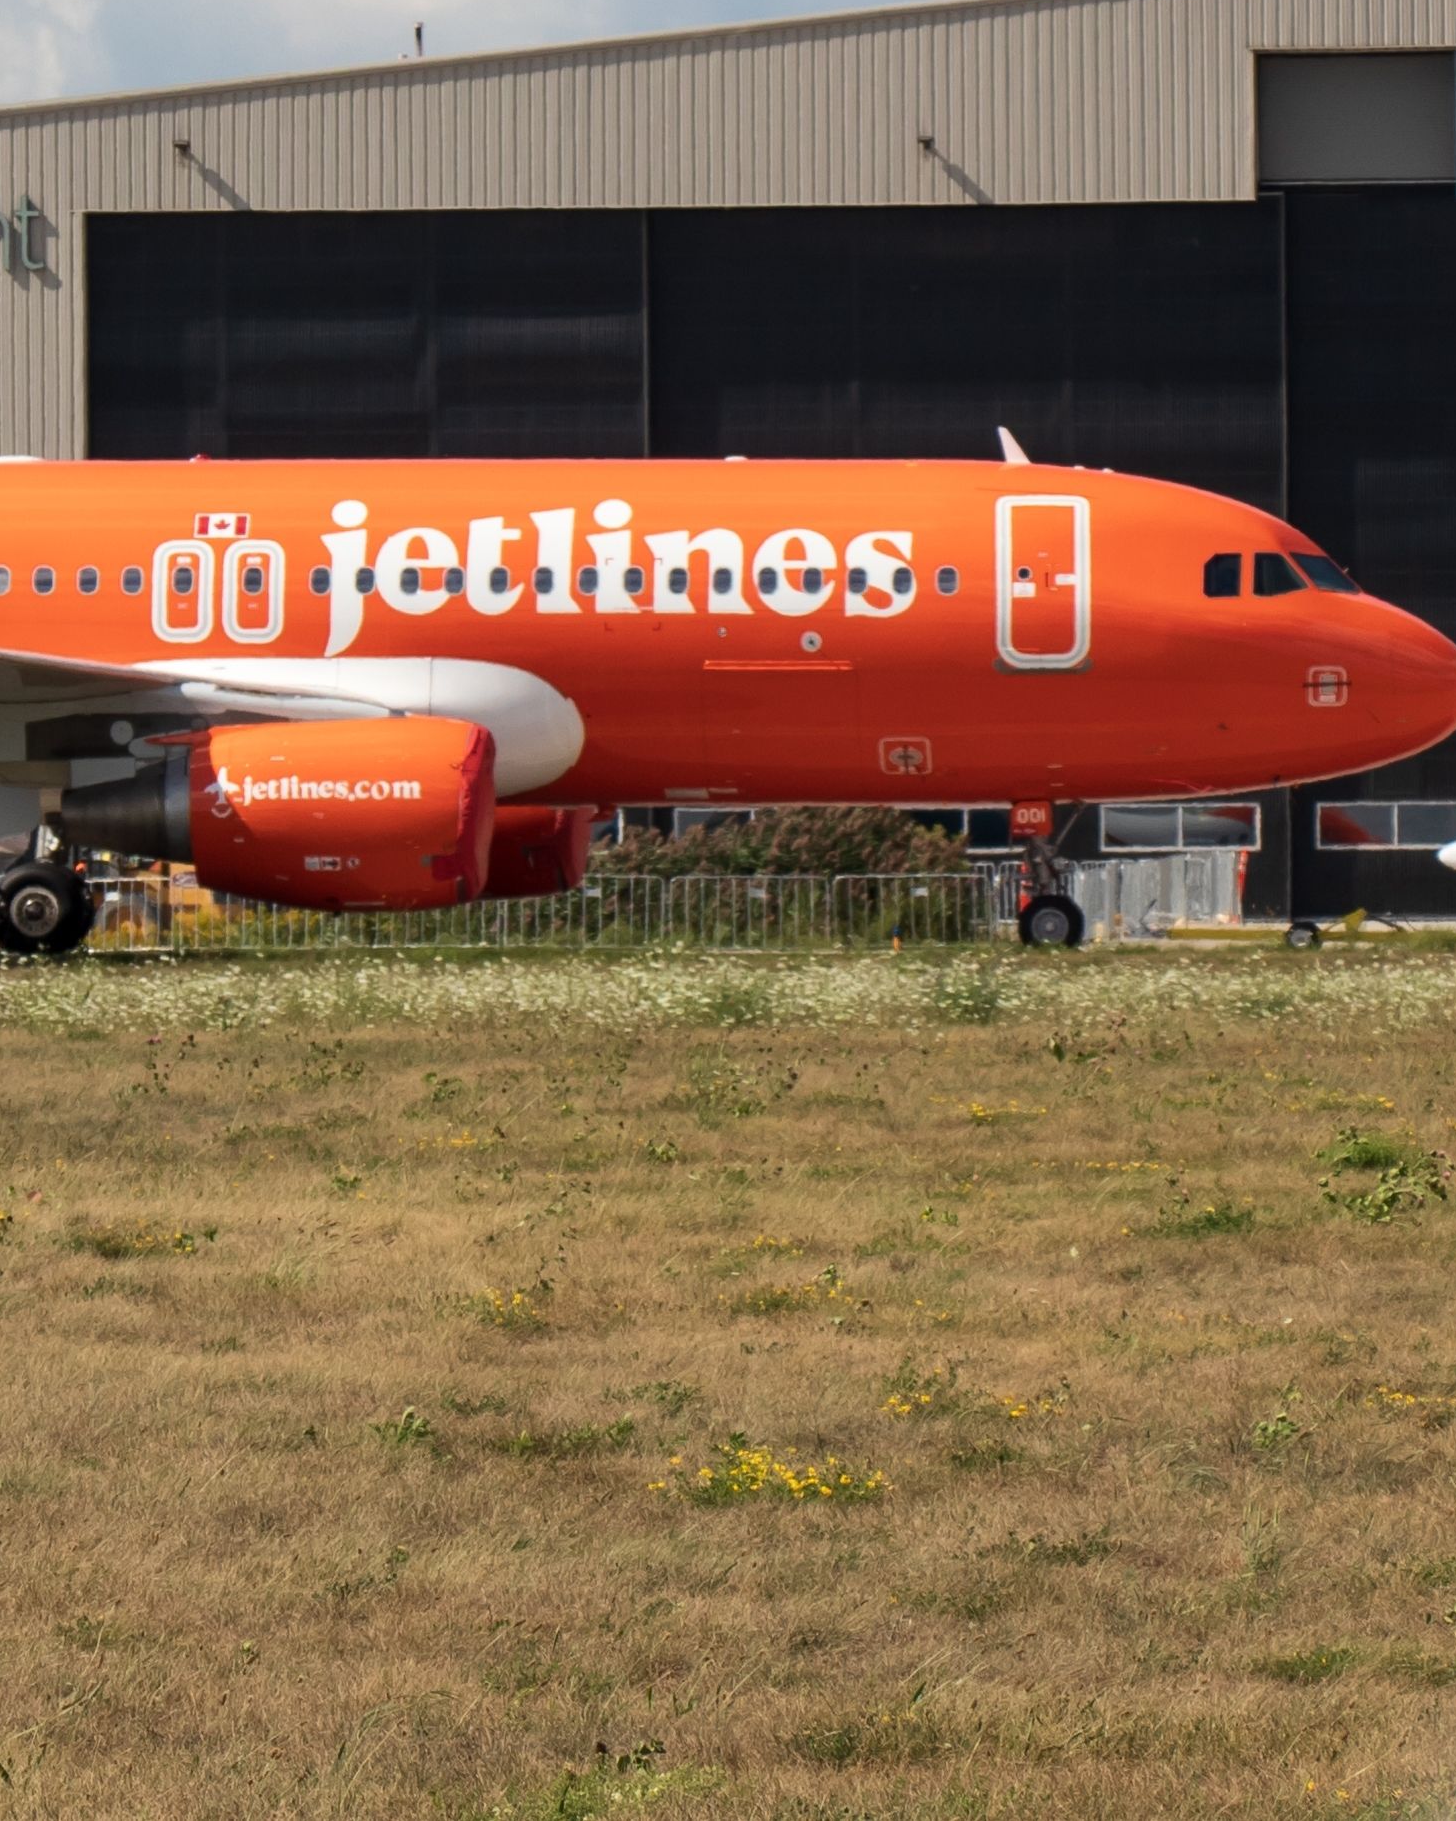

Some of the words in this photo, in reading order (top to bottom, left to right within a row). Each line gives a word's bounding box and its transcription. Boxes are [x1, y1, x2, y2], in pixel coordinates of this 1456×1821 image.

[320, 498, 917, 658] jetlines
[243, 775, 422, 806] jetlines.com
[1017, 808, 1046, 824] 001
